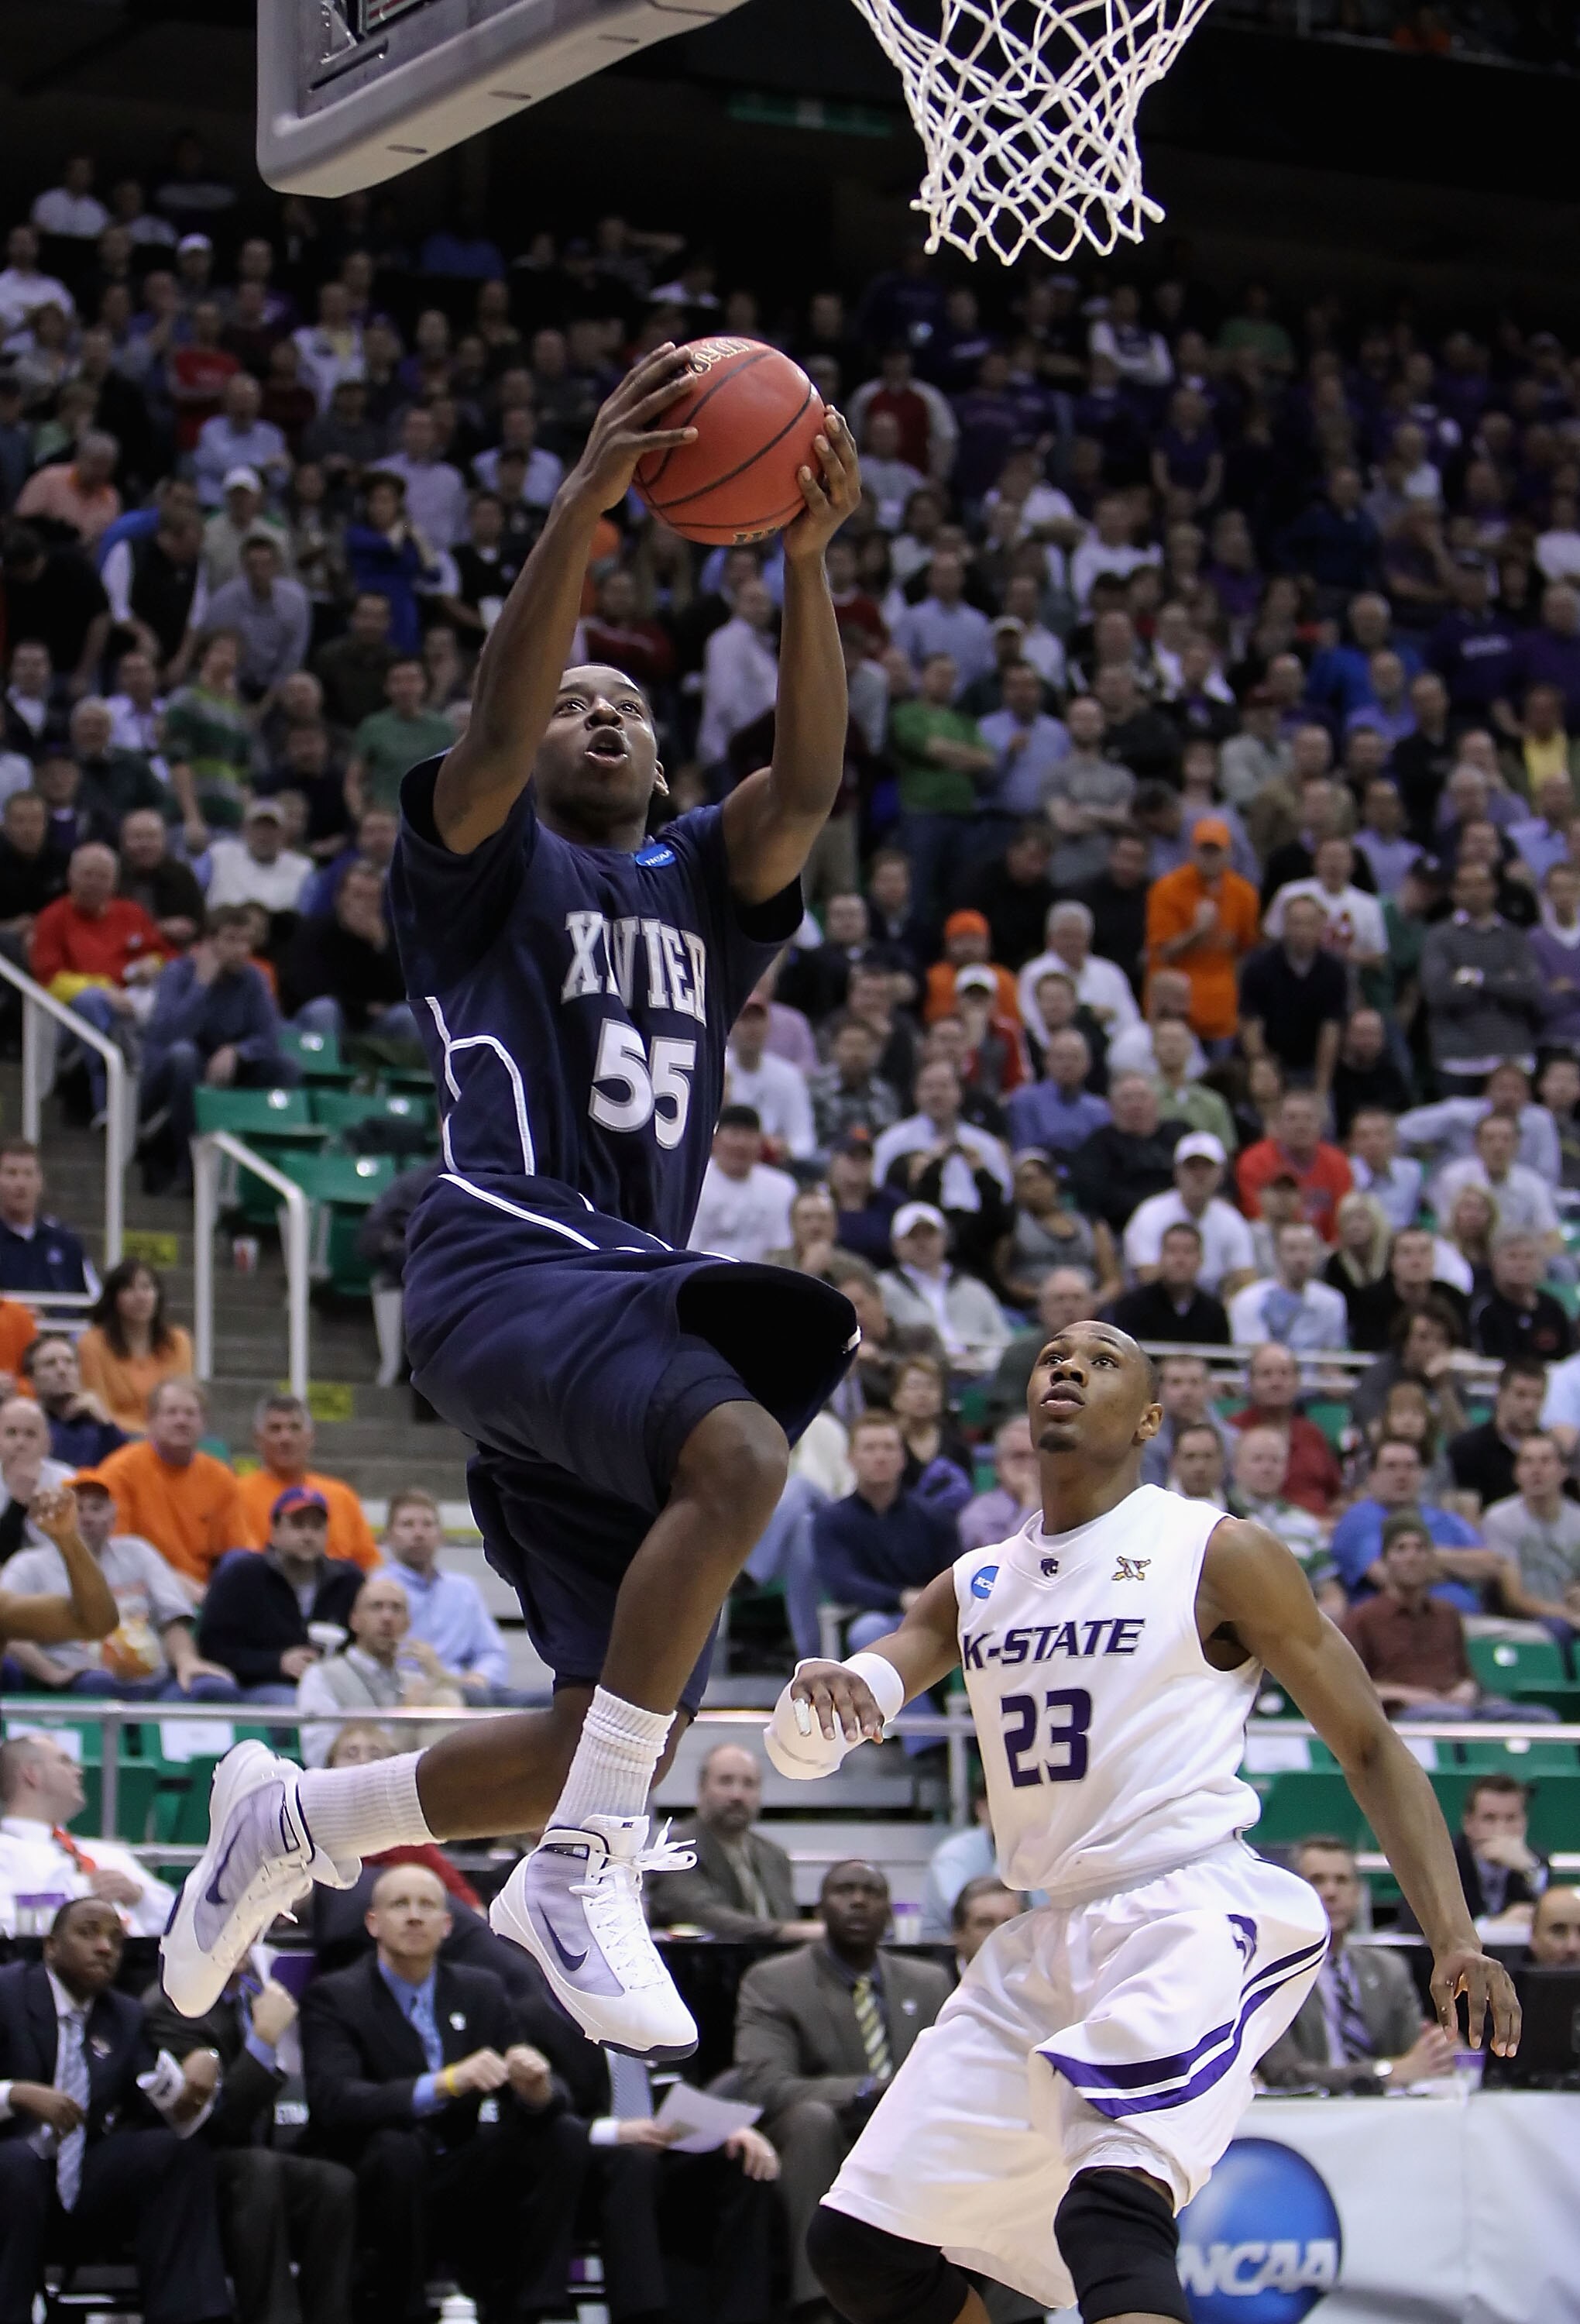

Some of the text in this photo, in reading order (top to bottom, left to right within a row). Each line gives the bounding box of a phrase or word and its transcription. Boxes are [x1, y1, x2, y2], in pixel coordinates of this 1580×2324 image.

[588, 1018, 697, 1150] 55
[963, 1618, 1146, 1671] K-STATE
[1000, 1688, 1093, 1789] 23
[1176, 2239, 1338, 2296] NCAA
